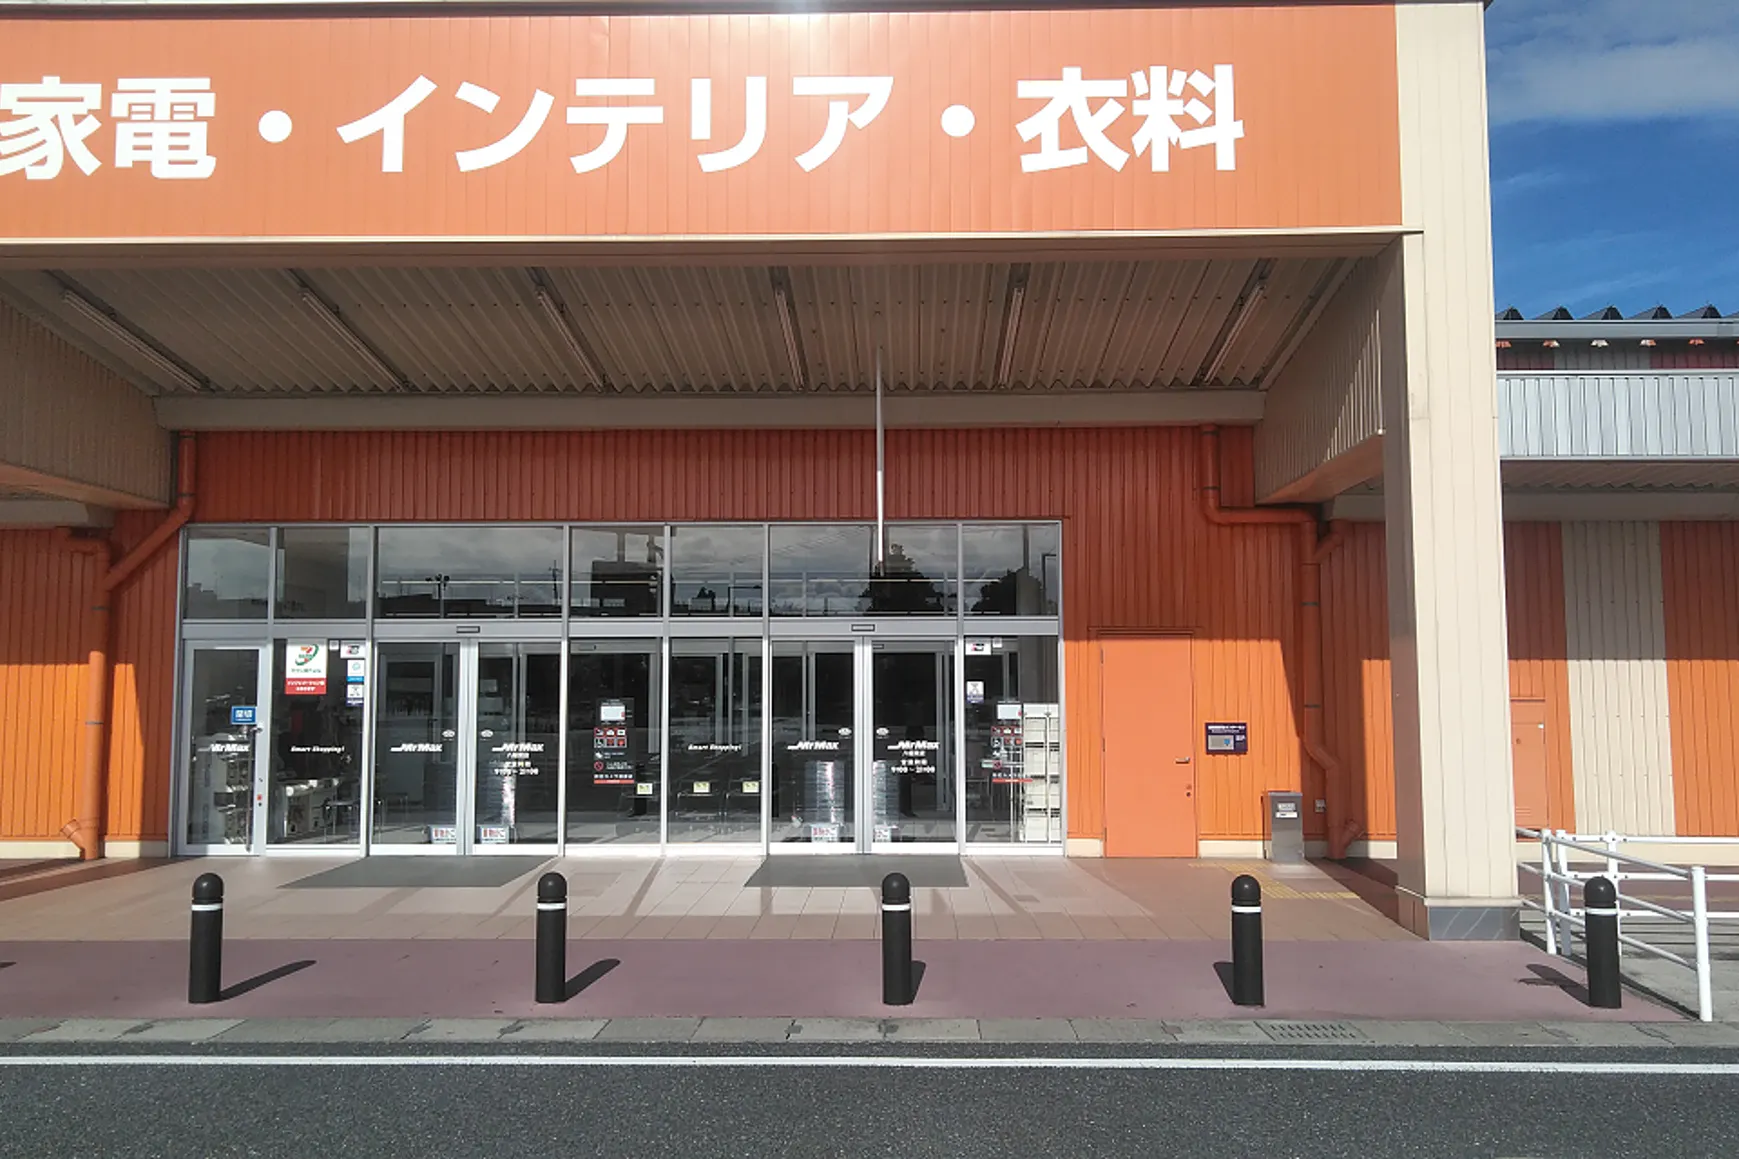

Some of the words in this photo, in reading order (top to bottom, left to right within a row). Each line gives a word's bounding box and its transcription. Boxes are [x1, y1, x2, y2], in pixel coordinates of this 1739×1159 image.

[0, 64, 1245, 181] 家電・インテリア・衣料
